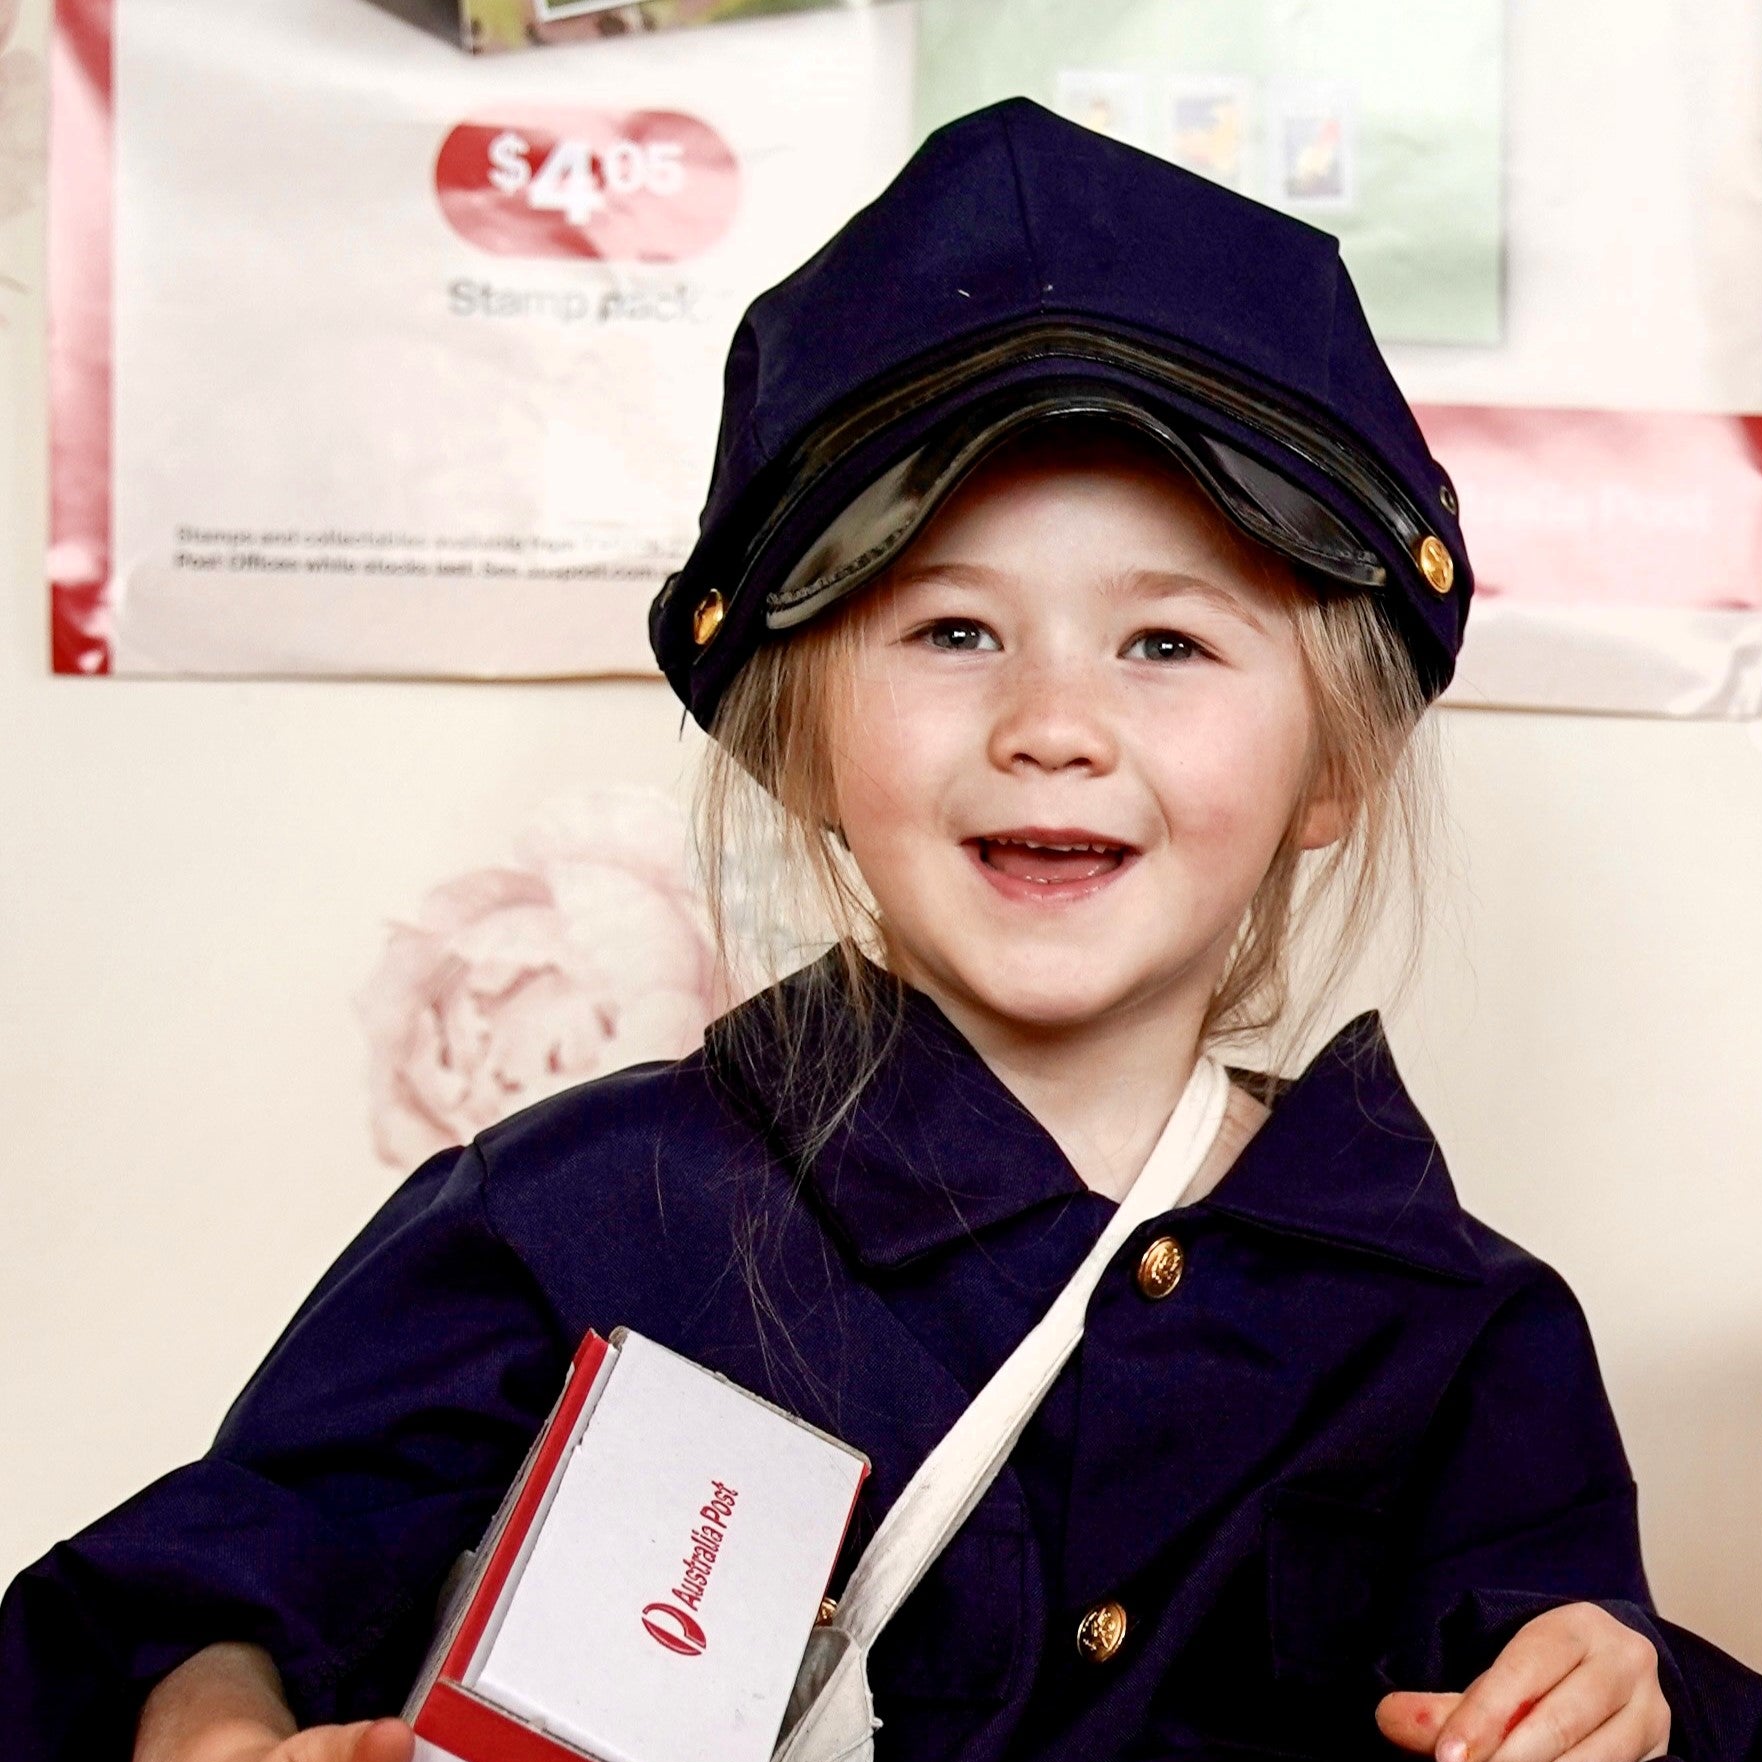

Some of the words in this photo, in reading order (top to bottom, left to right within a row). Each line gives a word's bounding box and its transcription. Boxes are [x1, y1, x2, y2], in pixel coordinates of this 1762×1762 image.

[449, 278, 588, 321] Stamp
[671, 1525, 725, 1613] Australia
[699, 1479, 739, 1530] Post
